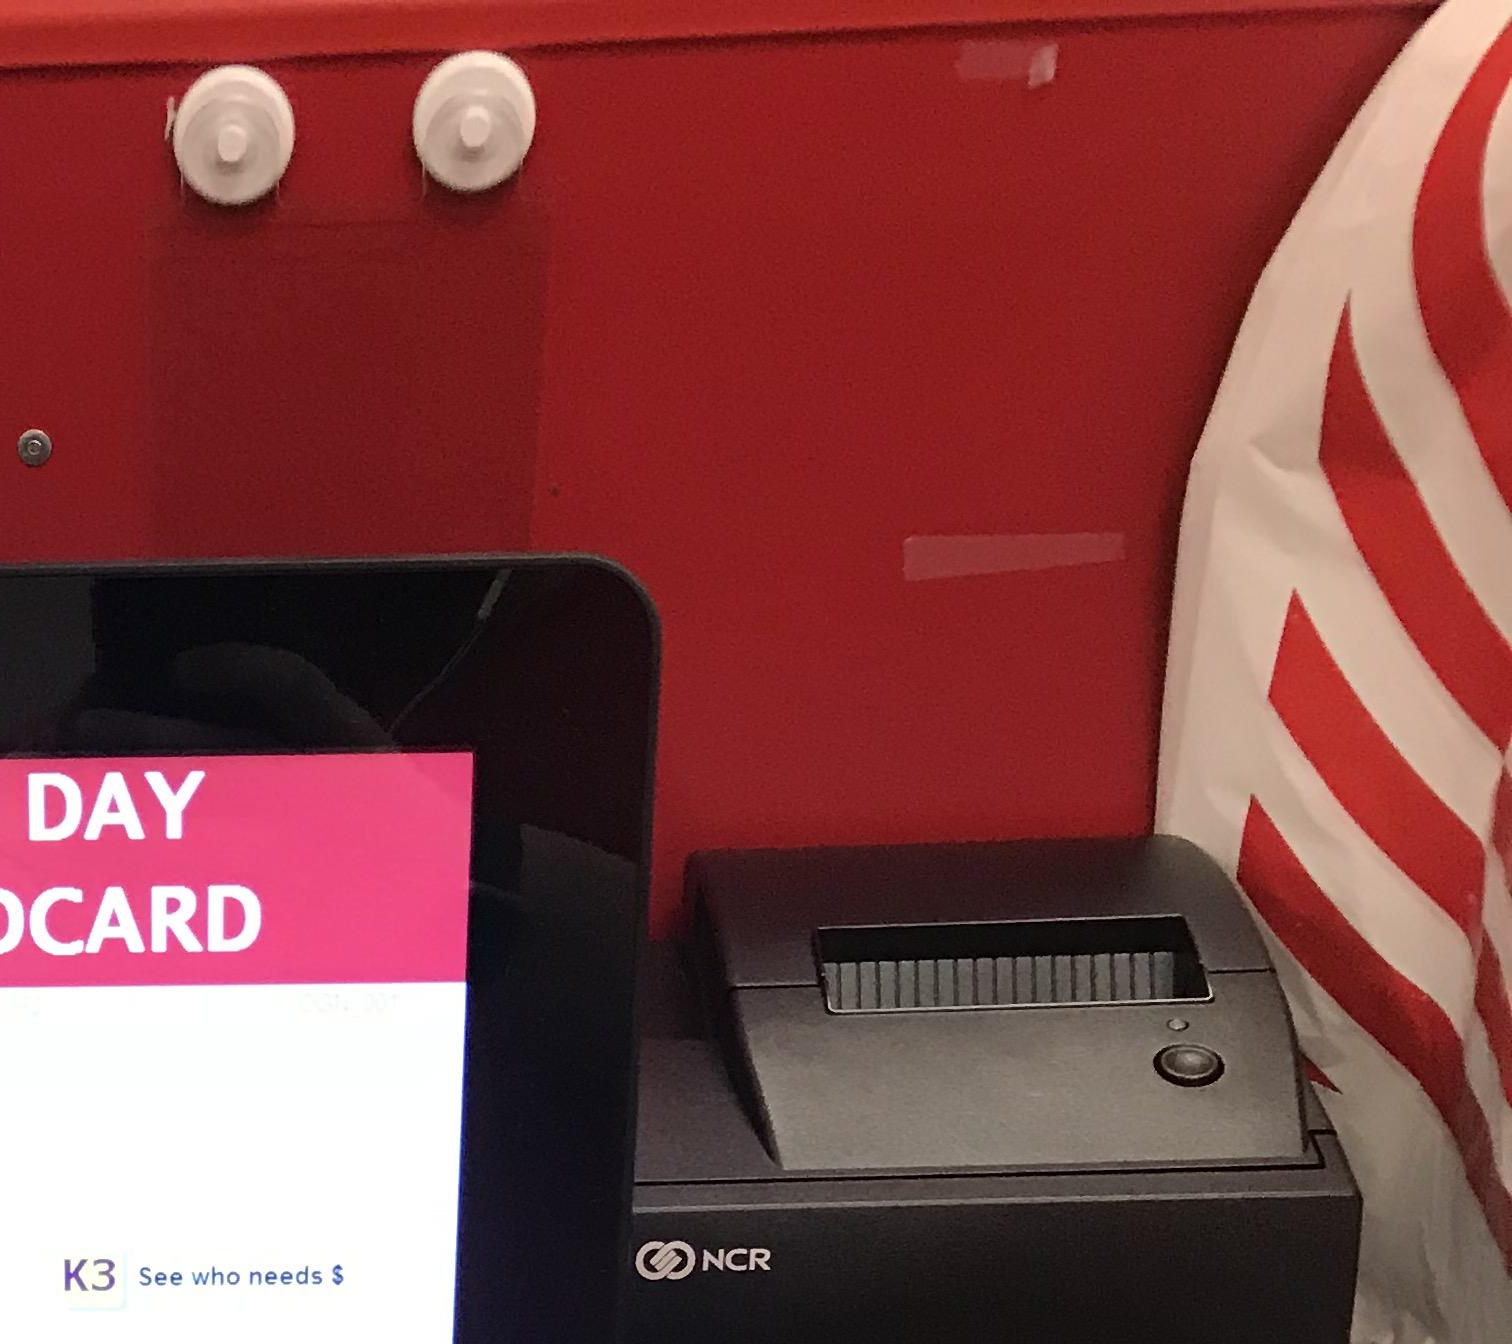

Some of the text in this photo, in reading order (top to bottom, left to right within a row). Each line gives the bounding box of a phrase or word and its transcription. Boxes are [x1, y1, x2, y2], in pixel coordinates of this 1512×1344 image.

[26, 770, 206, 842] DAY
[63, 1258, 345, 1292] K3 See who needs $
[701, 1247, 772, 1272] NCR
